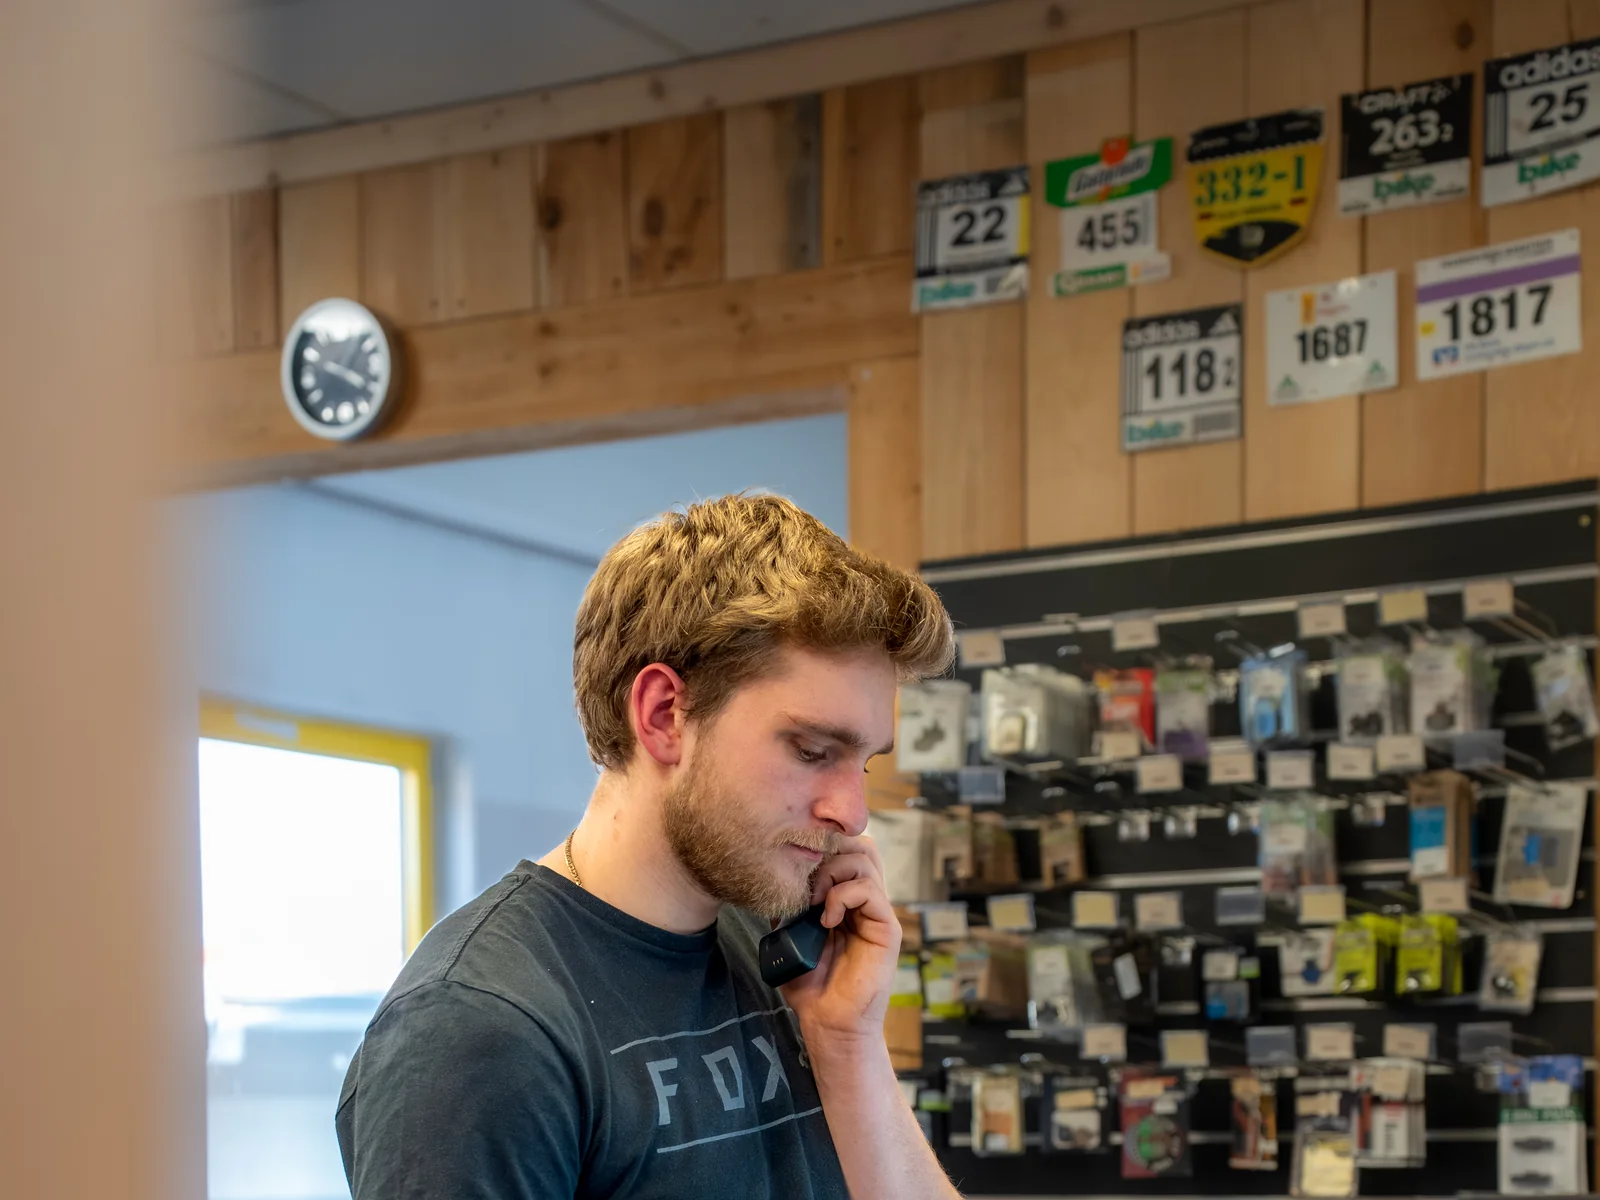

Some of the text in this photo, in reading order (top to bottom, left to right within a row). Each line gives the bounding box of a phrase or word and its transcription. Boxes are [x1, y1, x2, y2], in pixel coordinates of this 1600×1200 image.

[1368, 109, 1440, 155] 263
[1527, 82, 1589, 133] 25
[1195, 155, 1306, 206] 332-1
[951, 205, 1006, 247] 22
[1076, 209, 1140, 252] 455
[1442, 285, 1553, 342] 1817
[1294, 318, 1369, 365] 1687
[1146, 349, 1215, 399] 118
[646, 1035, 791, 1127] FOX
